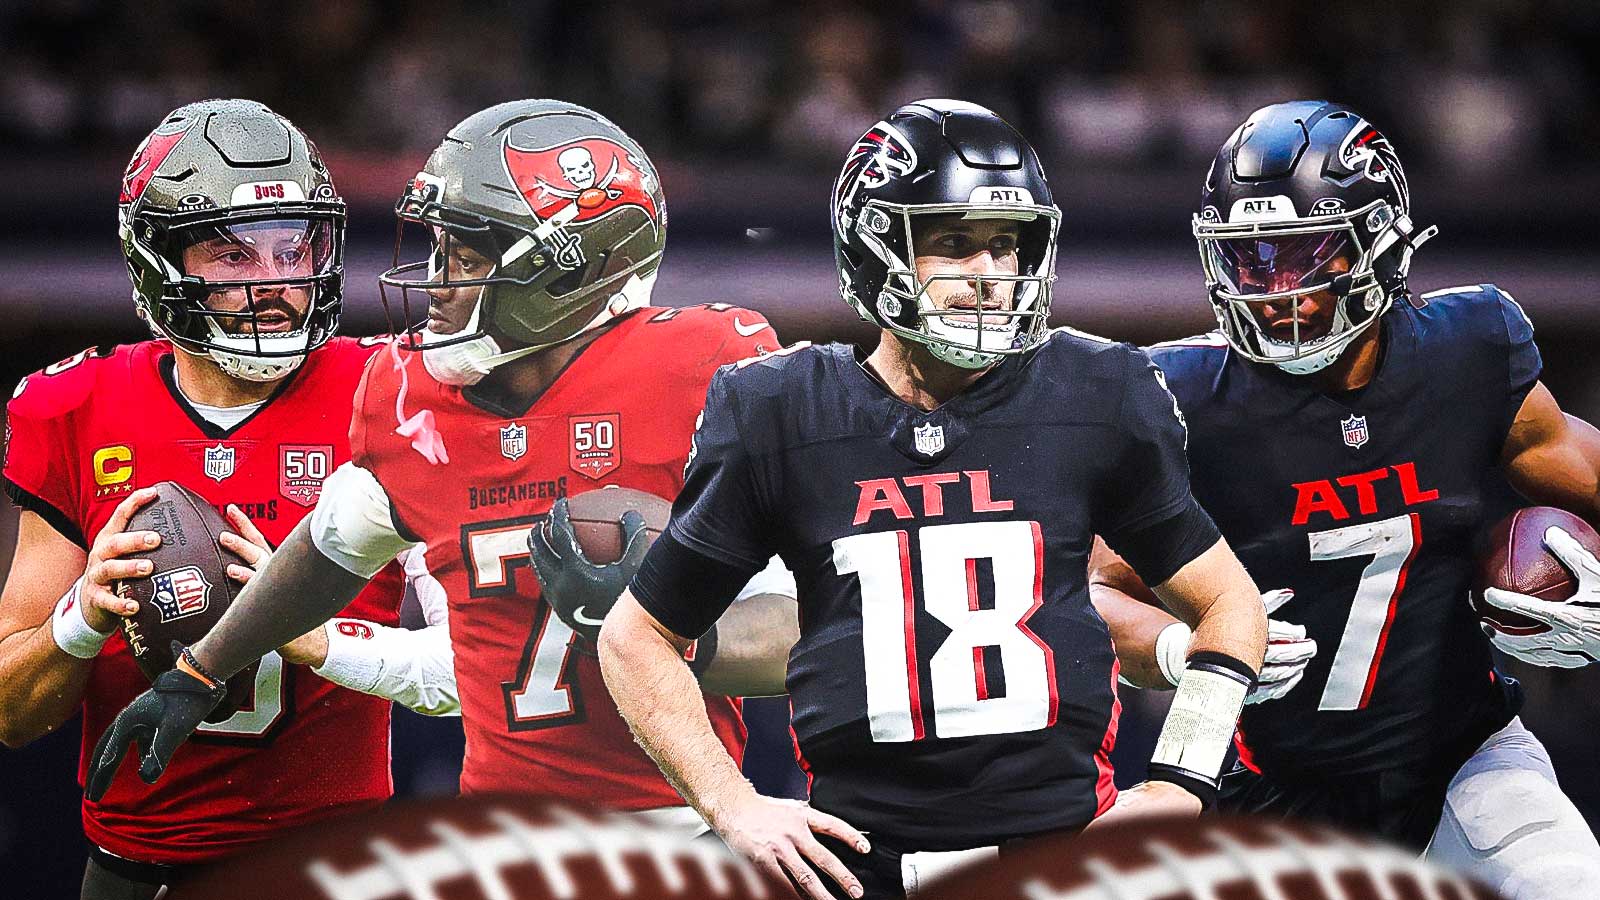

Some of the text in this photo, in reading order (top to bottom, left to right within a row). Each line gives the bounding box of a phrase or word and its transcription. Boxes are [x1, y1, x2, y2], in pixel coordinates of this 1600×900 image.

[990, 190, 1023, 202] ATL
[1243, 200, 1277, 212] ATL
[575, 420, 614, 451] 50
[93, 445, 133, 486] C
[285, 450, 327, 479] 50
[468, 476, 567, 510] BUCCANEERS
[852, 469, 1014, 525] ATL
[1291, 462, 1440, 526] ATL
[174, 571, 203, 612] NFL
[1307, 512, 1422, 712] 7
[463, 516, 583, 730] 7
[832, 520, 1059, 743] 18
